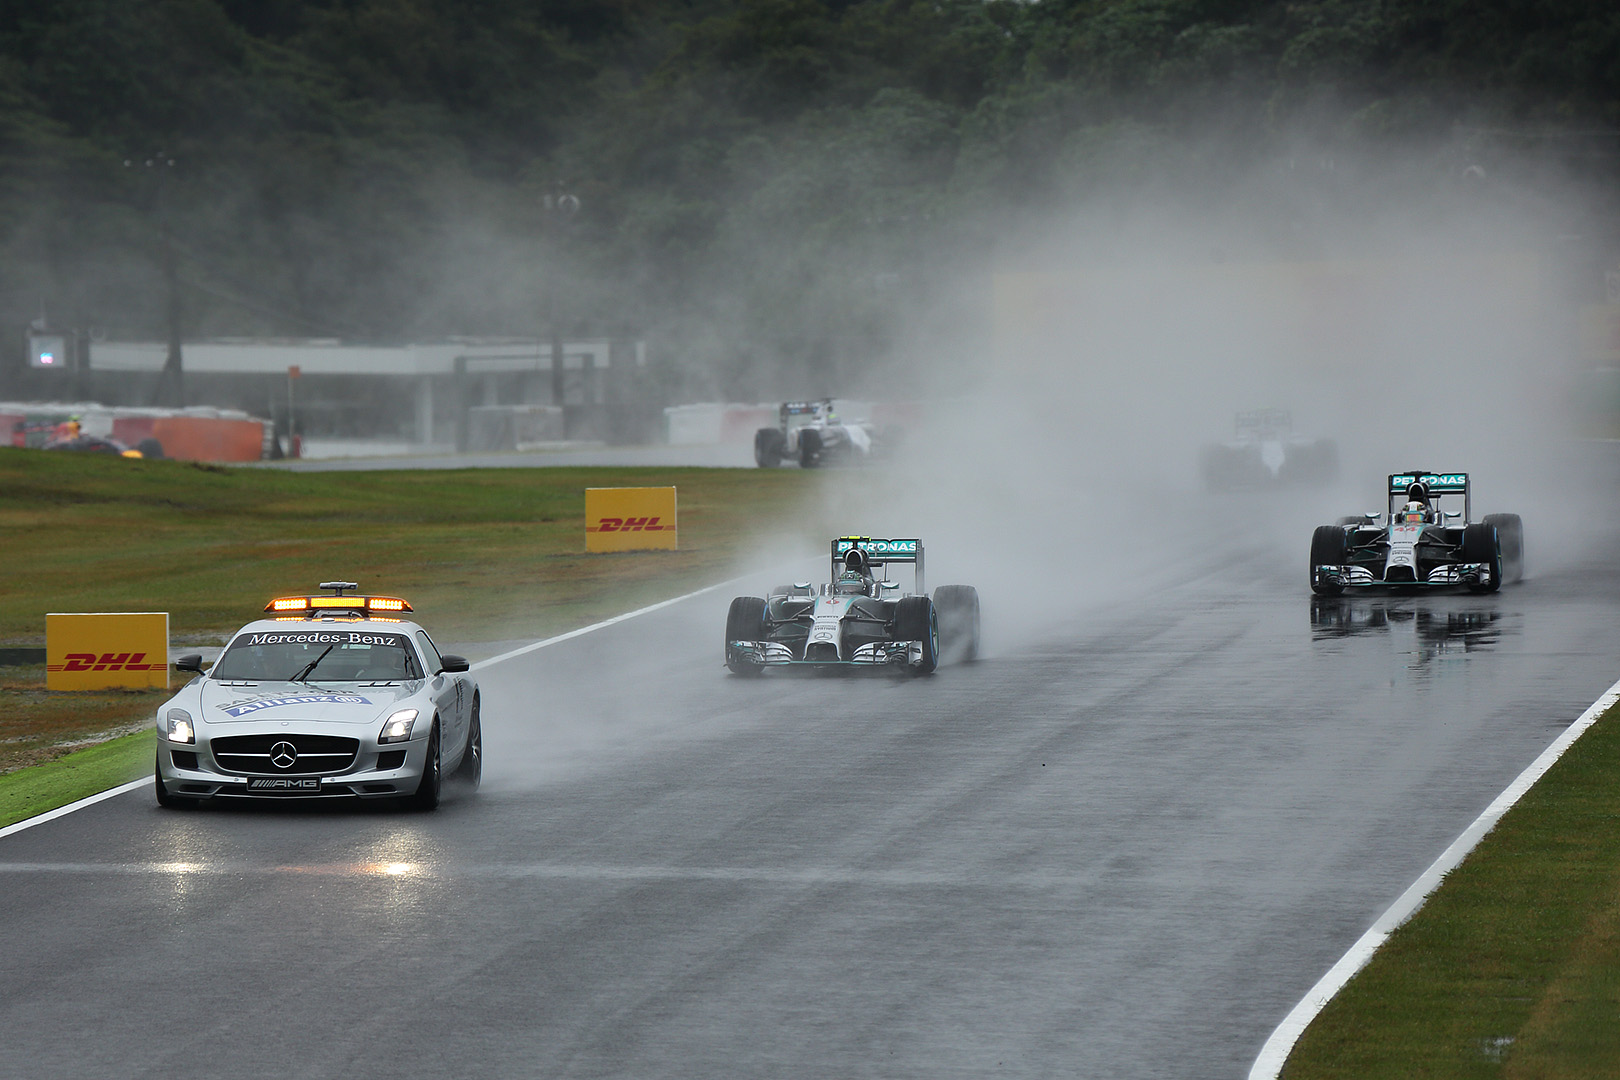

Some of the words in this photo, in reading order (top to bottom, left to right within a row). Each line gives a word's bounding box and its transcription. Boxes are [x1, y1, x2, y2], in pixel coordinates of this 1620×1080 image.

[599, 517, 664, 532] DHL
[248, 632, 396, 646] Mercedes-Benz
[64, 653, 151, 671] DHL
[238, 695, 332, 715] Allianz
[272, 779, 317, 788] AMG
